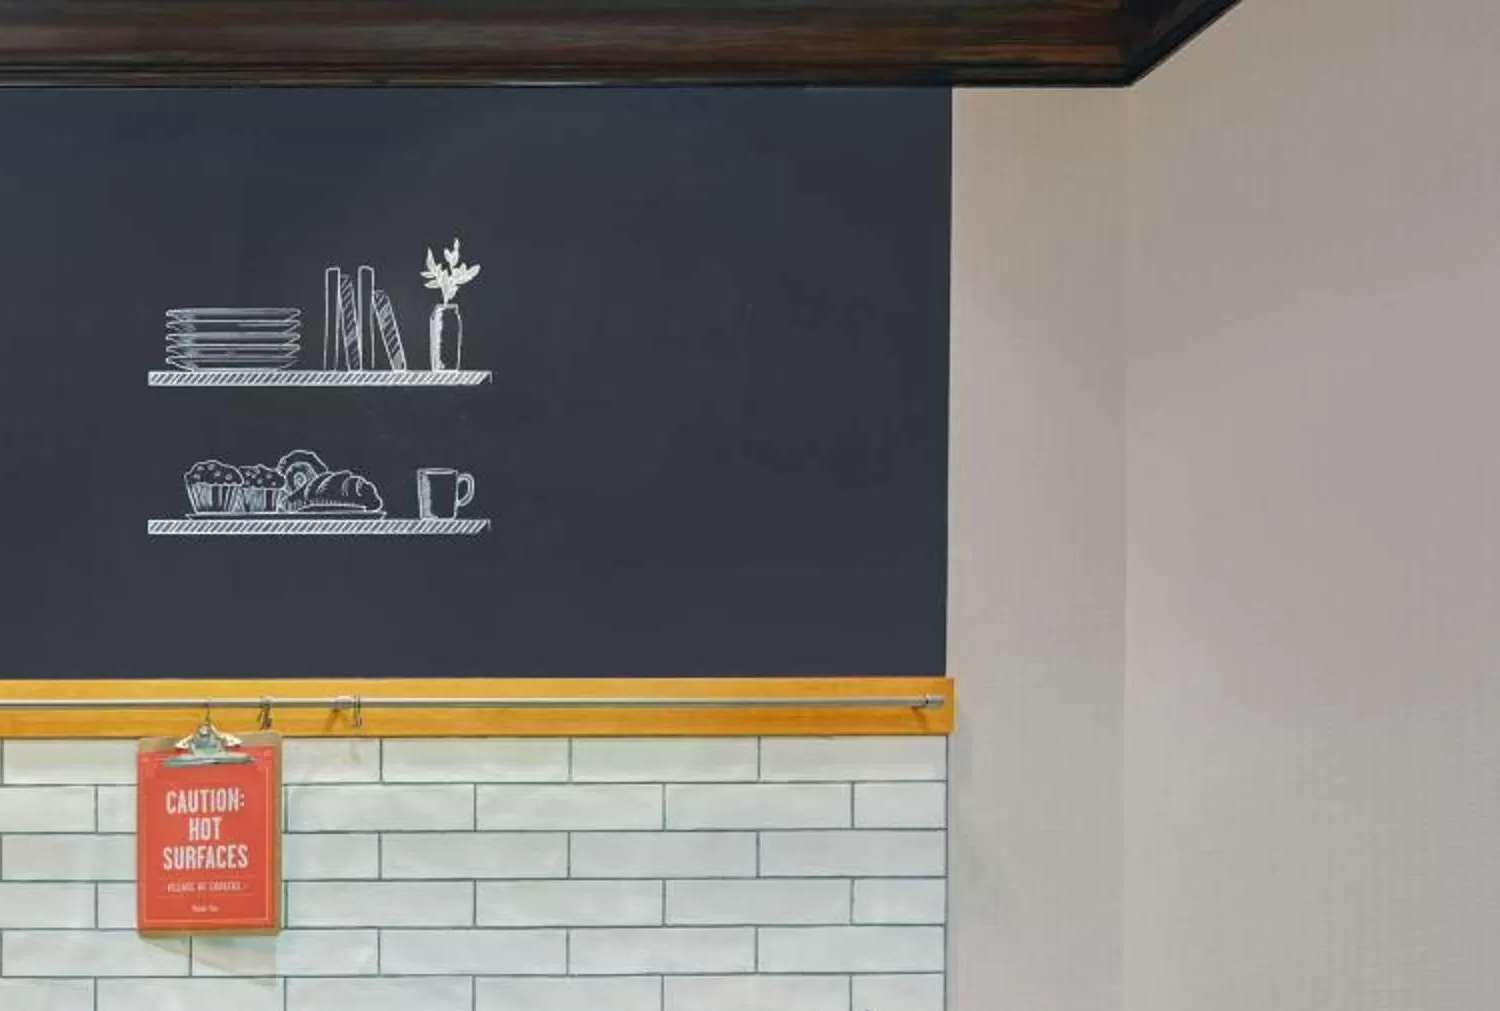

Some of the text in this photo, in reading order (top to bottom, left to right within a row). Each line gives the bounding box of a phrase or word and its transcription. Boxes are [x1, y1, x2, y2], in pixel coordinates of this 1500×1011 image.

[166, 787, 245, 815] CAUTION:
[189, 817, 222, 841] HOT
[163, 844, 249, 870] SURFACES
